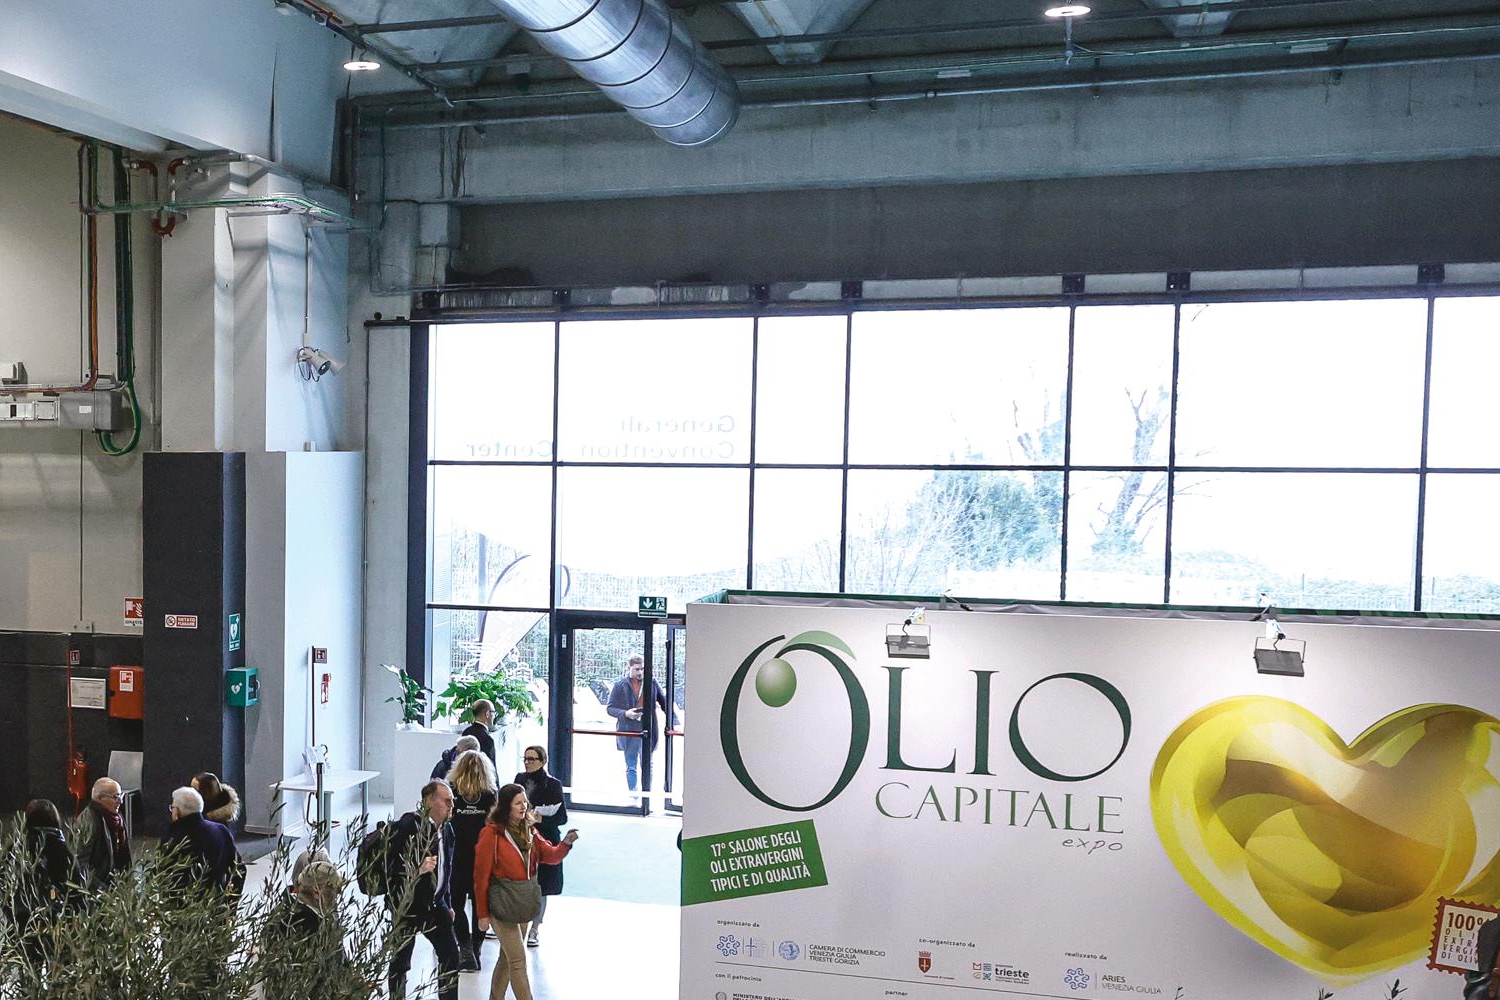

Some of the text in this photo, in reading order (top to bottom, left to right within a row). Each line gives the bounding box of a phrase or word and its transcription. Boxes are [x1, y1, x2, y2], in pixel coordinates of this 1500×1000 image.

[719, 632, 1132, 812] OLIO
[874, 781, 1125, 834] CAPITALE
[728, 835, 769, 855] SALONE
[770, 830, 802, 848] DEGLI
[1061, 837, 1124, 855] expo
[710, 847, 804, 874] OLI EXTRAVERGINI
[710, 862, 811, 892] TIPICI E DI QUALITÀ
[1448, 912, 1486, 931] 100
[1445, 928, 1476, 940] OLI
[918, 938, 967, 947] co-organizzato
[1444, 935, 1476, 948] EXTR
[809, 944, 836, 953] CAMERA
[844, 947, 886, 957] COMMERCIO
[809, 950, 857, 960] VENEZIA GIULIA
[1064, 952, 1098, 960] realizzato
[1443, 943, 1478, 956] VERGI
[809, 955, 860, 966] TRIESTE GORIZIA
[1441, 951, 1479, 965] DI OLIV
[995, 967, 1030, 978] trieste
[1101, 974, 1126, 984] ARIES
[885, 989, 909, 997] partner
[1101, 982, 1162, 995] VENEZIA GIULIA
[732, 993, 763, 1000] MINISTERO
